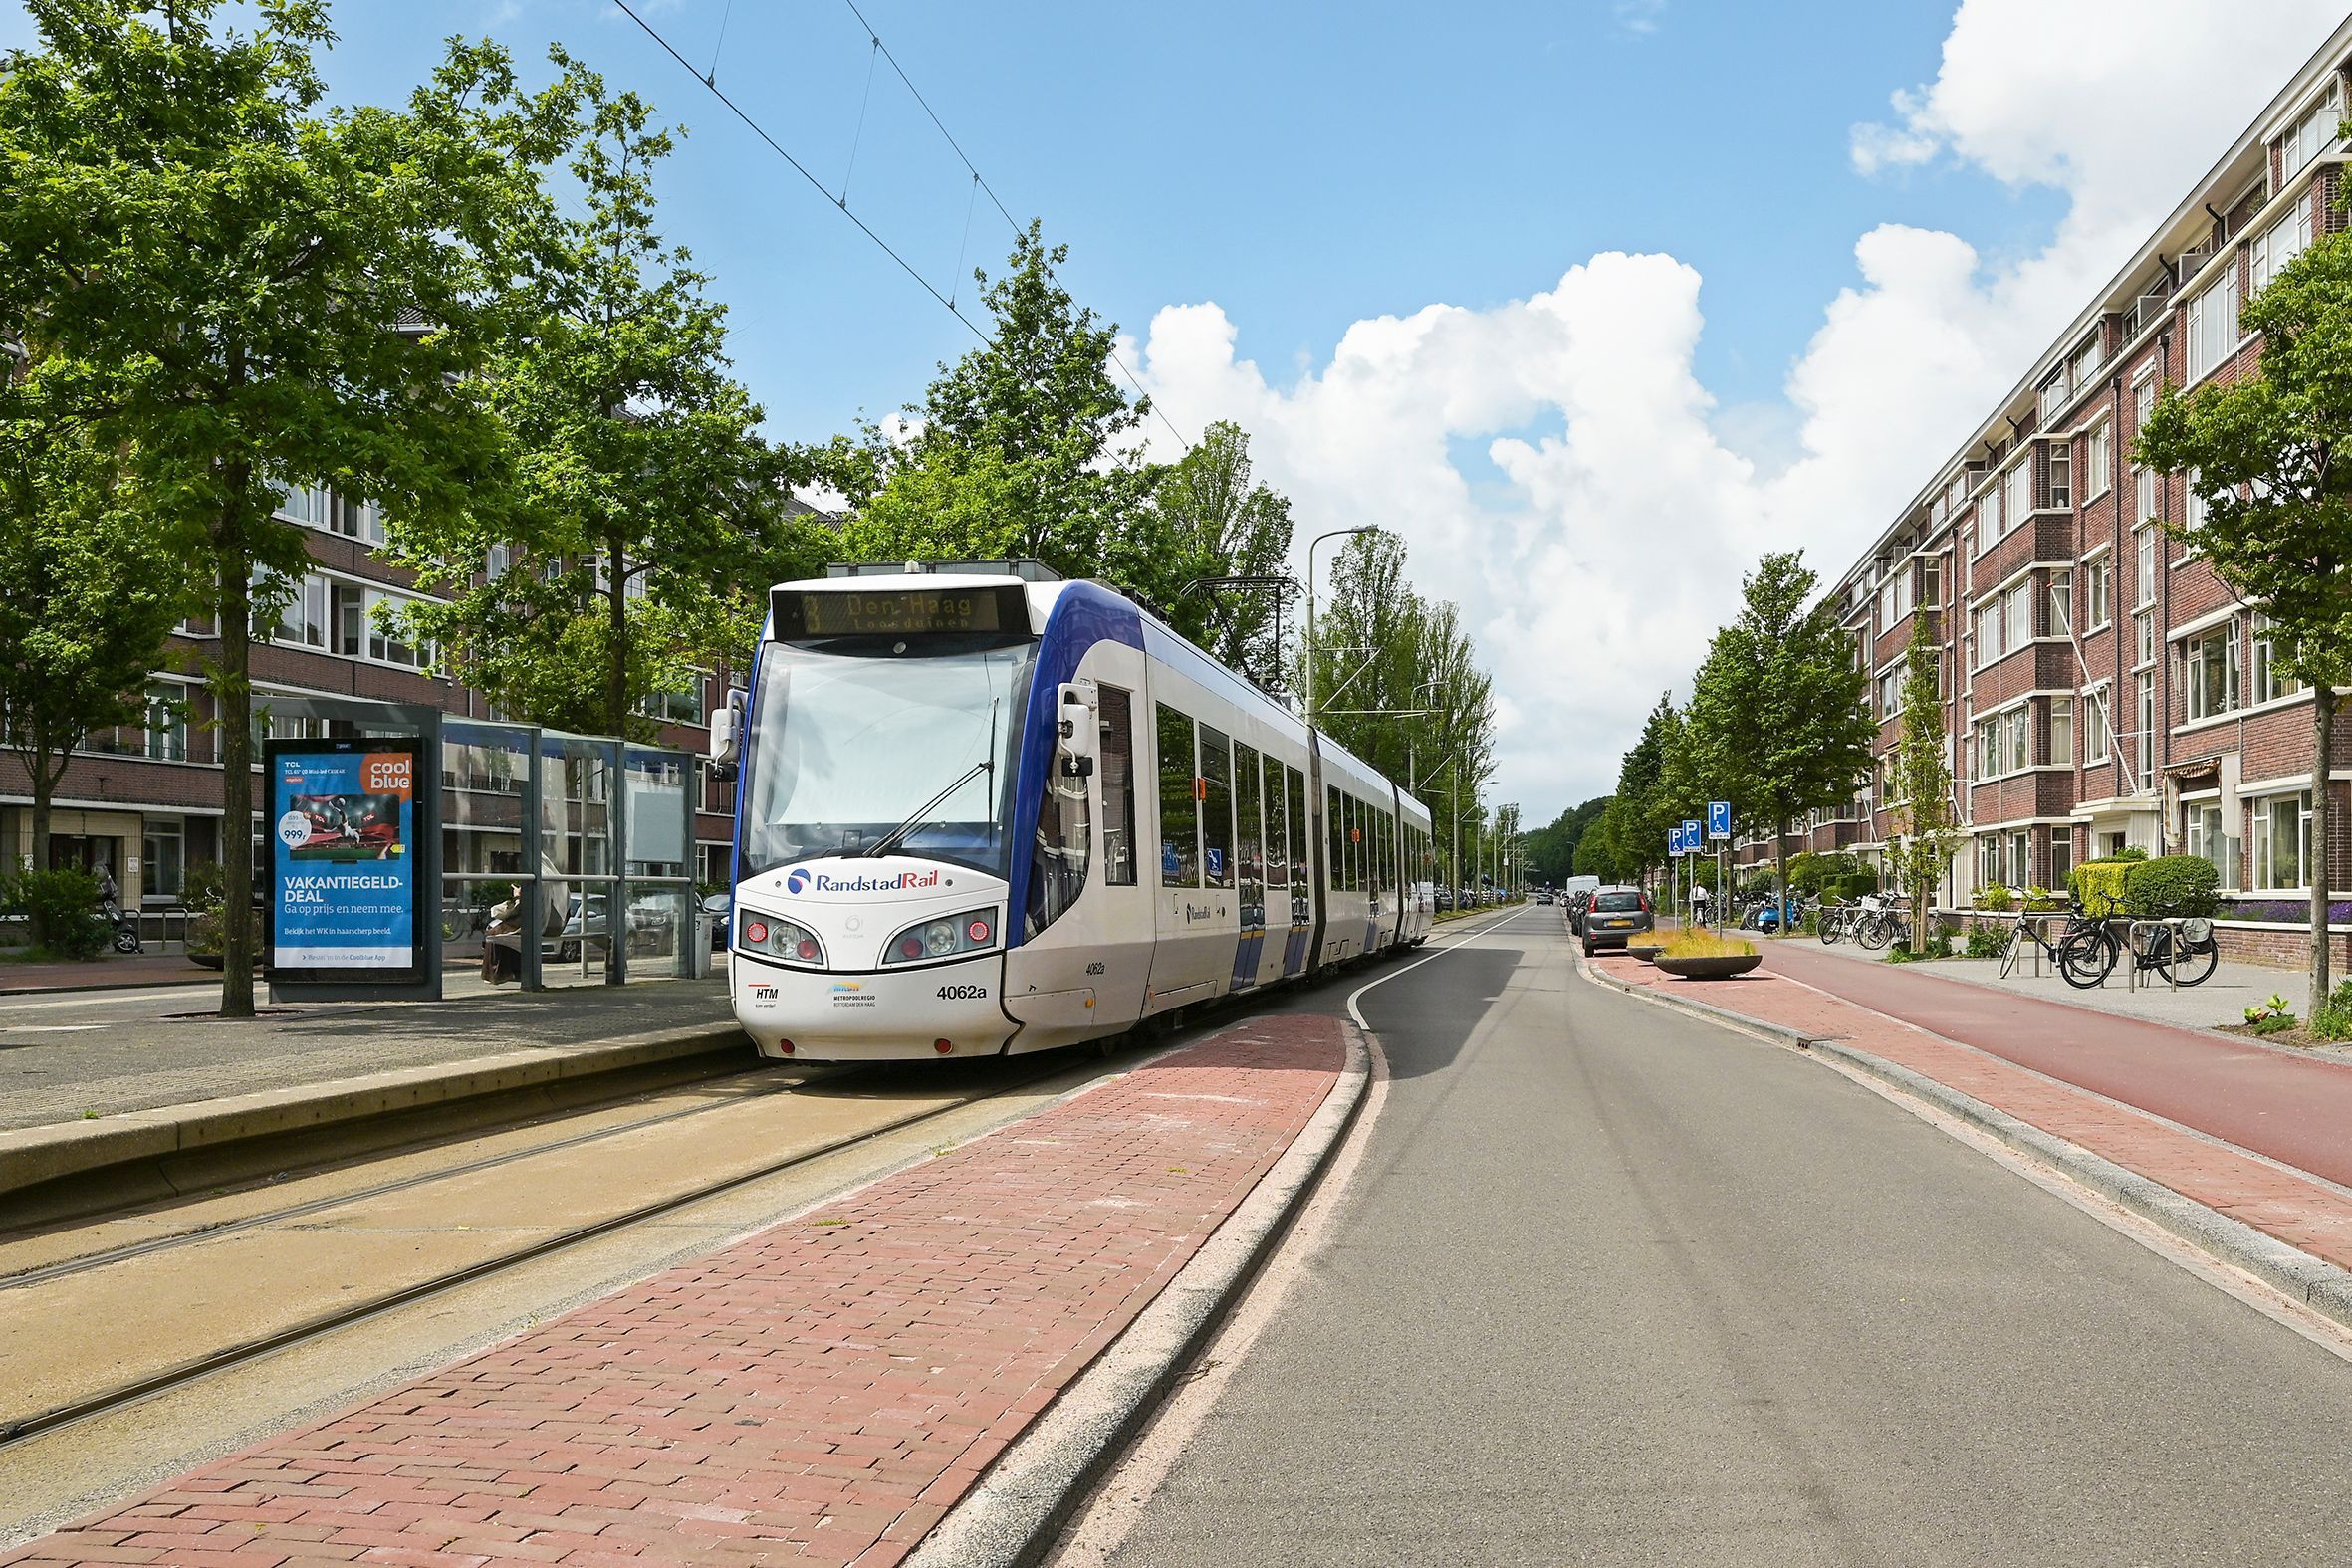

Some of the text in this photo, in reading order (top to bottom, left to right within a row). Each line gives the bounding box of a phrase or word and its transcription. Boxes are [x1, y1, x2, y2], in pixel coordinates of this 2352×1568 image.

[848, 593, 972, 616] Den Haag
[370, 760, 410, 774] cool
[370, 775, 410, 789] blue
[1713, 804, 1725, 820] P
[1686, 822, 1697, 836] P
[1673, 830, 1681, 843] P
[284, 876, 403, 889] VAKANTIEGELD-
[817, 870, 938, 891] RandstadRail
[284, 890, 324, 903] DEAL
[284, 903, 404, 916] Ga op prijs en neem mee.
[284, 927, 304, 936] Bekijk
[336, 927, 372, 936] haarscherp
[756, 988, 779, 999] HTM
[936, 985, 988, 1001] 4062a
